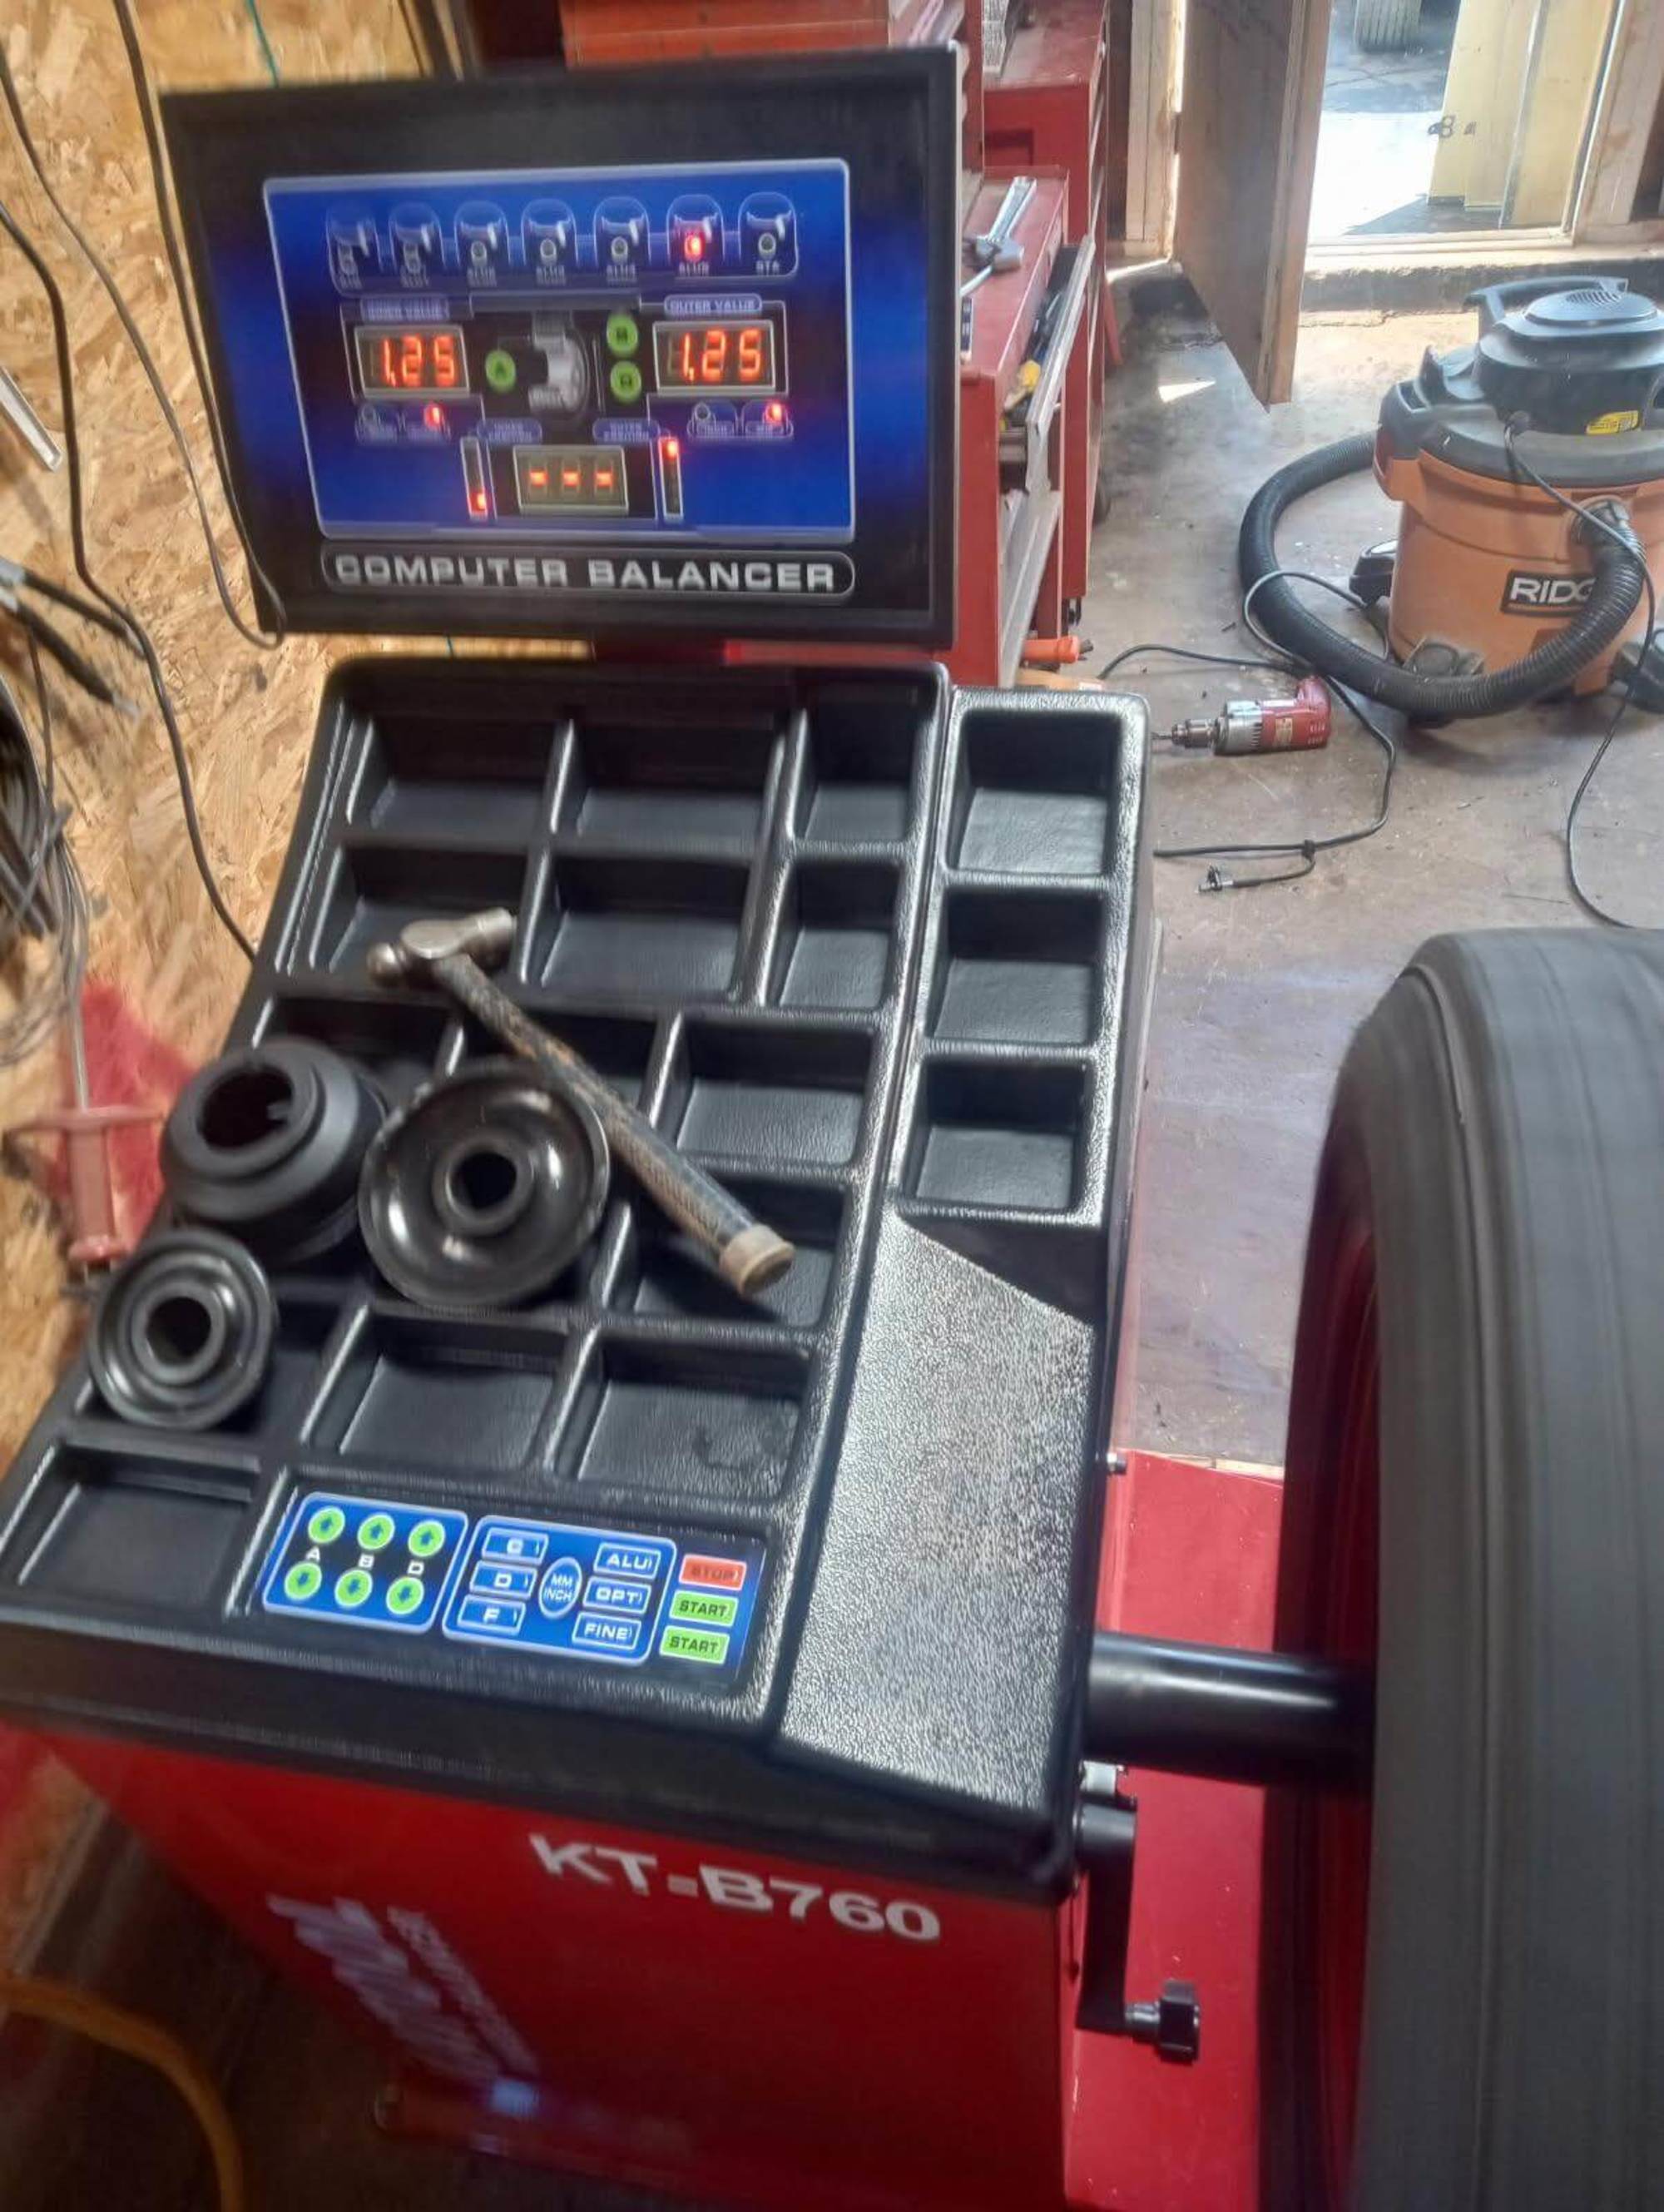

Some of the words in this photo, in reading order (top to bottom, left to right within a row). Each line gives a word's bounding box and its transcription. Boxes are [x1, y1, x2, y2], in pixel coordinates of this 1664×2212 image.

[714, 298, 755, 313] VALUE
[682, 329, 761, 382] 1.25
[334, 554, 569, 587] COMPUTER
[587, 558, 834, 591] BALANCER
[305, 1546, 321, 1562] A
[358, 1554, 374, 1570] B
[606, 1554, 650, 1570] ALU
[407, 1560, 425, 1575] D
[493, 1573, 513, 1589] D
[551, 1574, 573, 1588] MM
[544, 1589, 573, 1602] INCH
[596, 1586, 639, 1604] OPT
[483, 1606, 501, 1623] F
[679, 1599, 728, 1617] START
[584, 1622, 630, 1640] FINE
[669, 1634, 719, 1654] START
[529, 1833, 940, 1941] KT-B760
